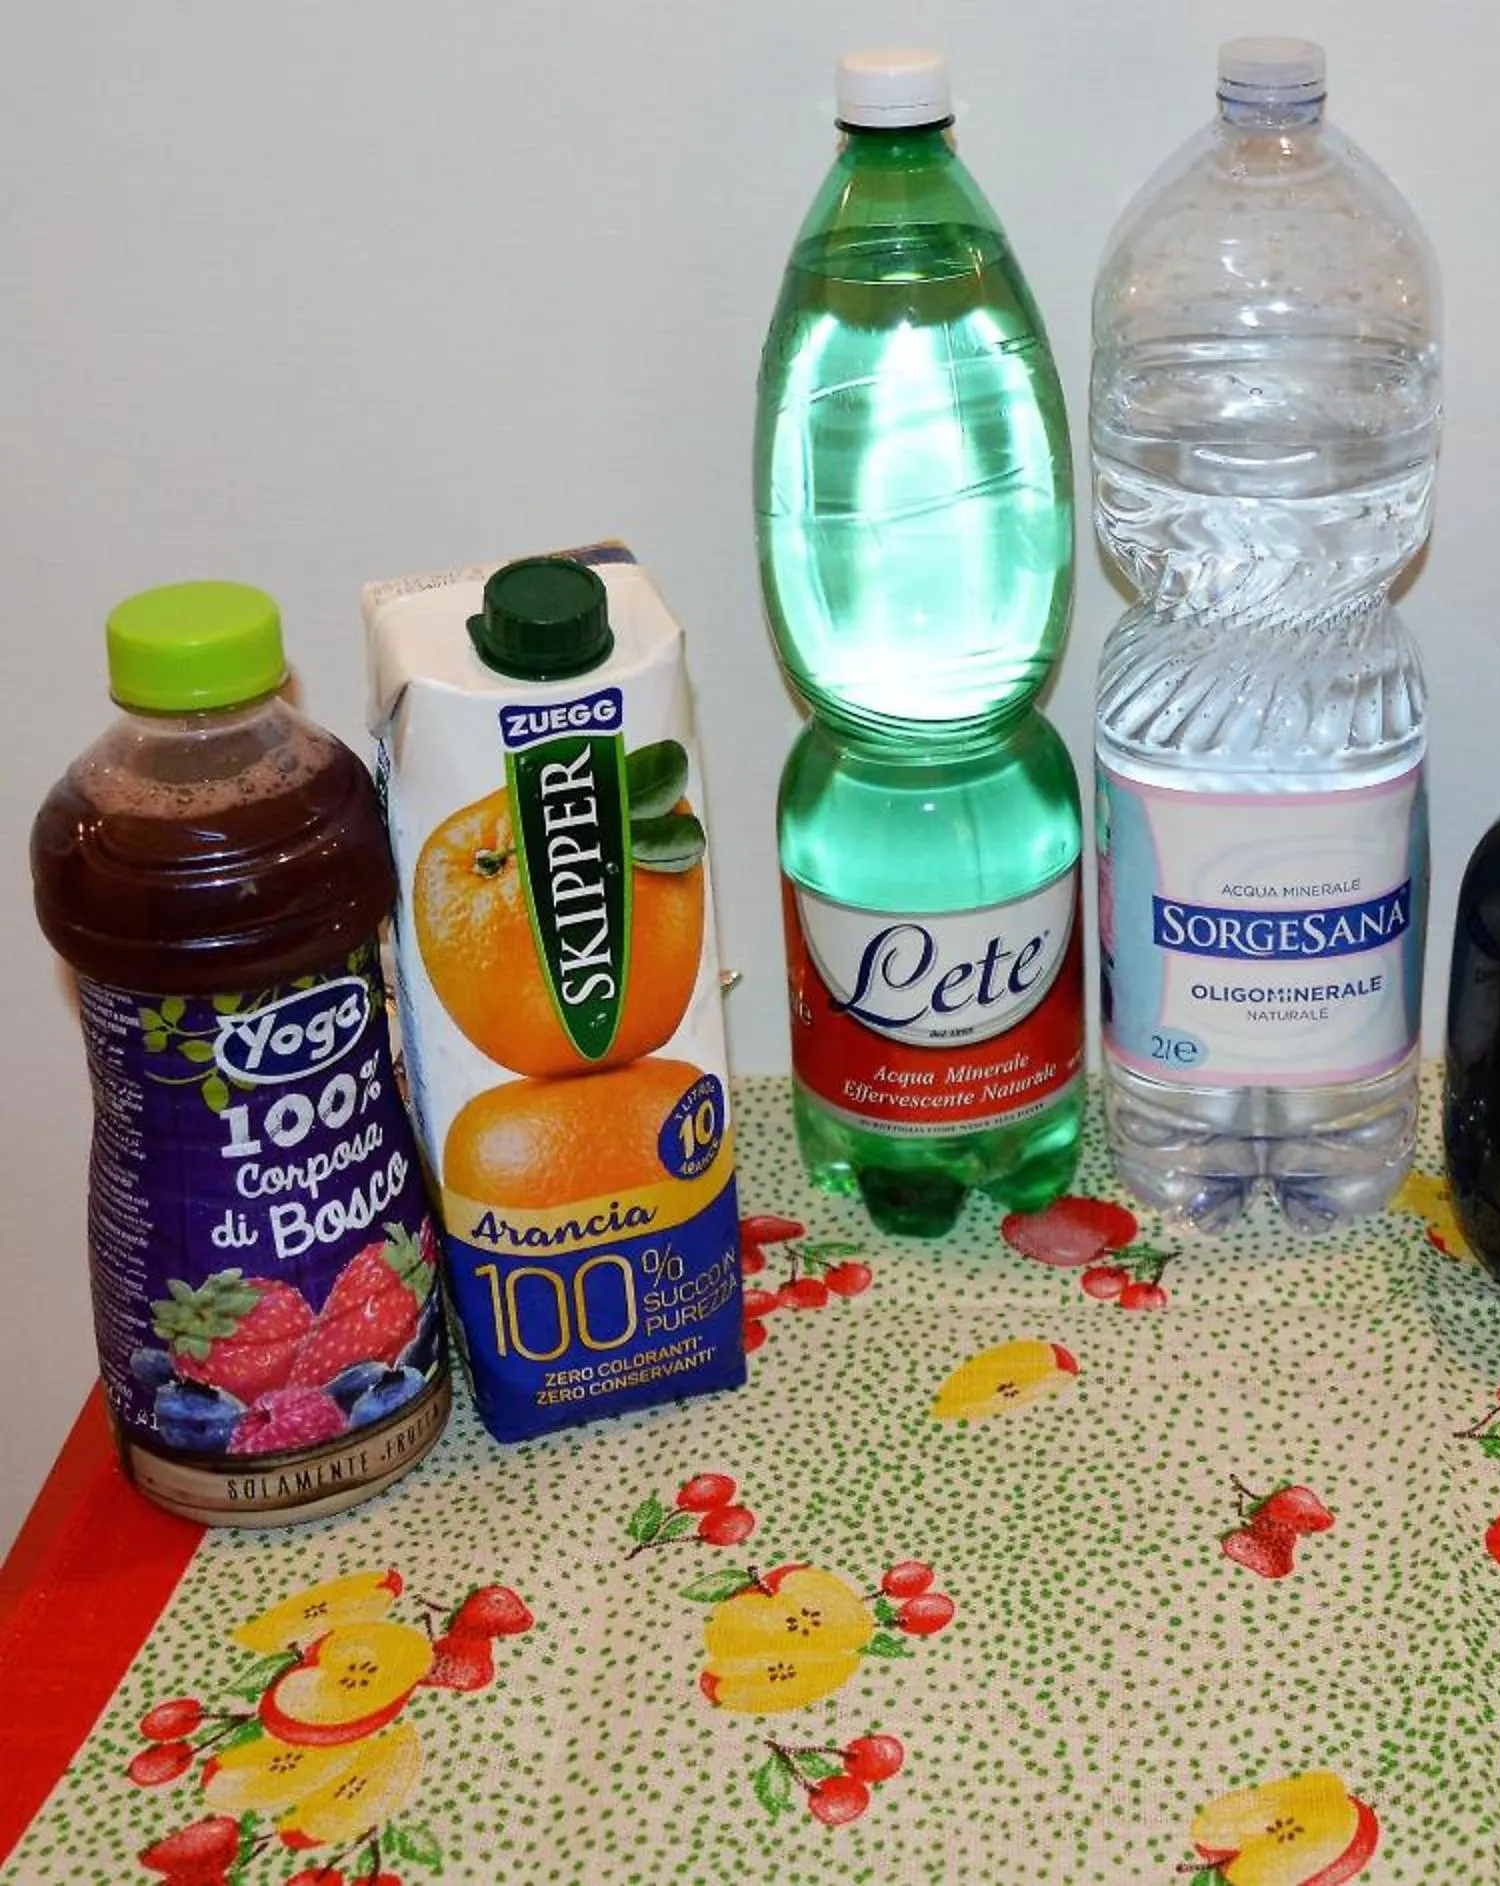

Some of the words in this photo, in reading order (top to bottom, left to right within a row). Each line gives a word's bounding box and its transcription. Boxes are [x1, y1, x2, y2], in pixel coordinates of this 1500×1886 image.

[505, 699, 617, 737] ZUEGG
[539, 741, 615, 1006] SKIPPER
[1221, 883, 1278, 897] ACQUA
[1283, 878, 1361, 898] MINERALE
[829, 923, 1045, 1029] Lete
[1191, 975, 1383, 1004] OLIGOMINERALE
[235, 992, 362, 1070] Yoga
[1247, 1006, 1329, 1022] NATURALE
[842, 1080, 975, 1108] Effervescente
[981, 1063, 1057, 1102] Naturale
[873, 1065, 935, 1088] Acqua
[945, 1052, 1030, 1083] Minerale
[219, 1050, 381, 1159] 100%
[679, 1099, 715, 1159] 10
[236, 1121, 383, 1199] Corposa
[211, 1208, 259, 1248] di
[269, 1151, 409, 1259] Bosco
[471, 1201, 659, 1247] Arancia
[643, 1264, 720, 1313] SUCCO
[536, 1386, 585, 1405] ZERO
[544, 1367, 594, 1387] ZERO
[227, 1452, 368, 1500] SOLAMENTE
